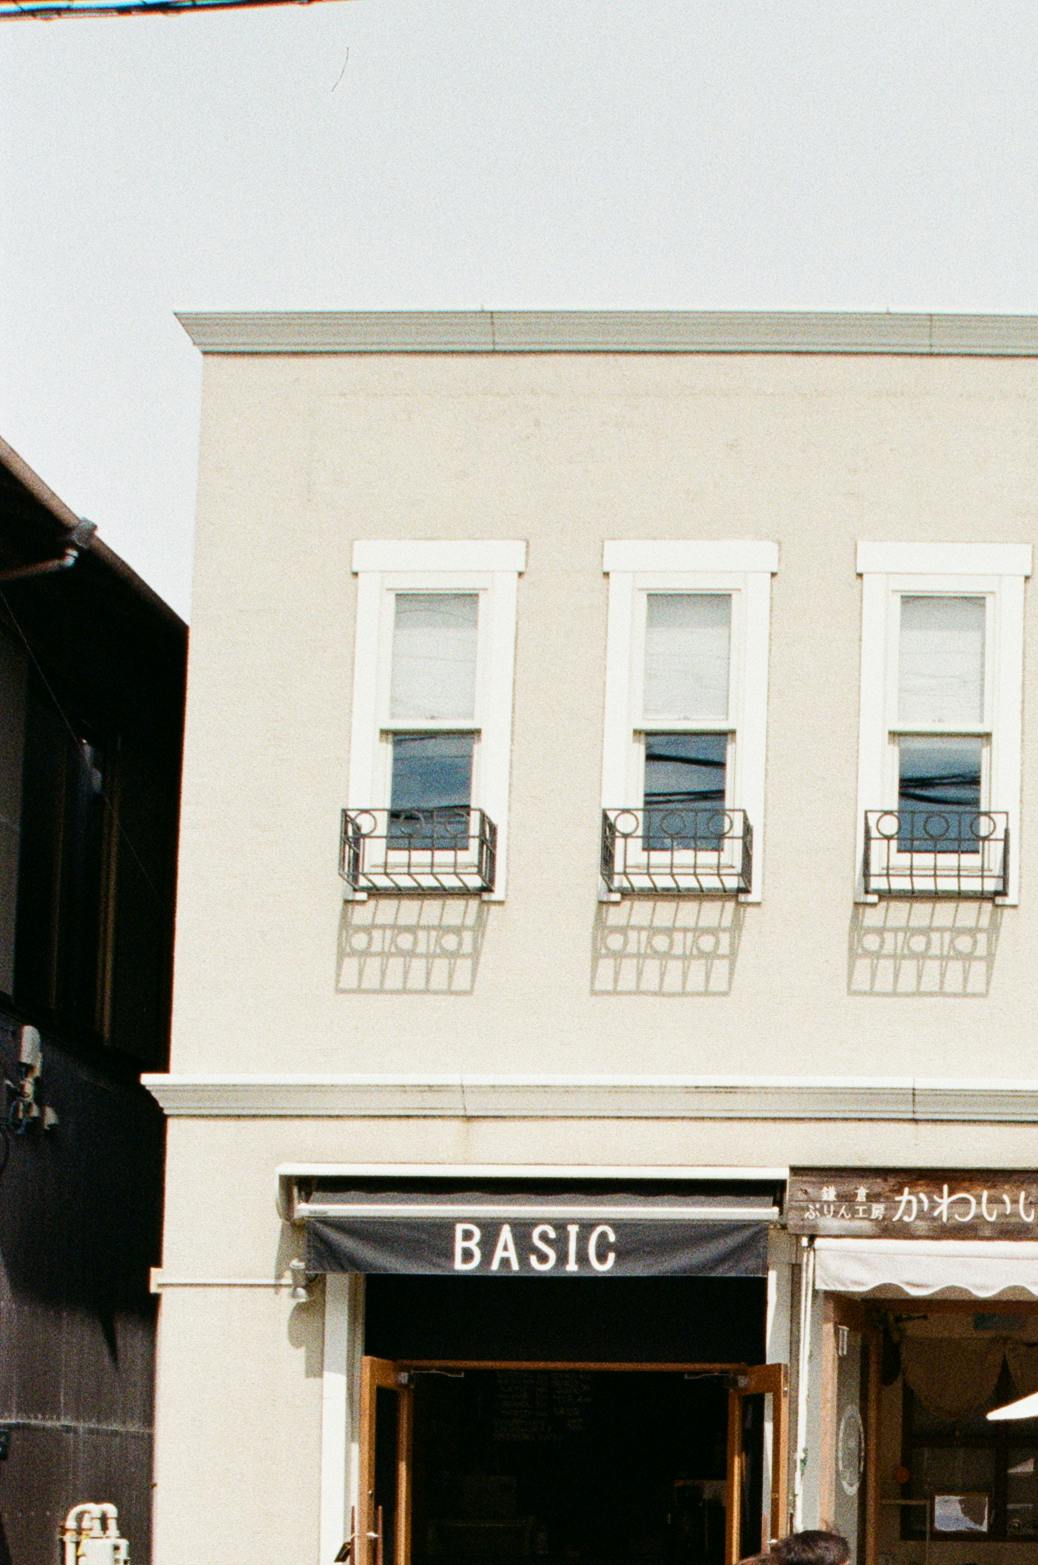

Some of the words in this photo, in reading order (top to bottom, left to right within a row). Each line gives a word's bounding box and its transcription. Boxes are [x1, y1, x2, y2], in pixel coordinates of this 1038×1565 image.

[803, 1203, 885, 1221] ぷりん工房
[453, 1223, 618, 1273] BASIC
